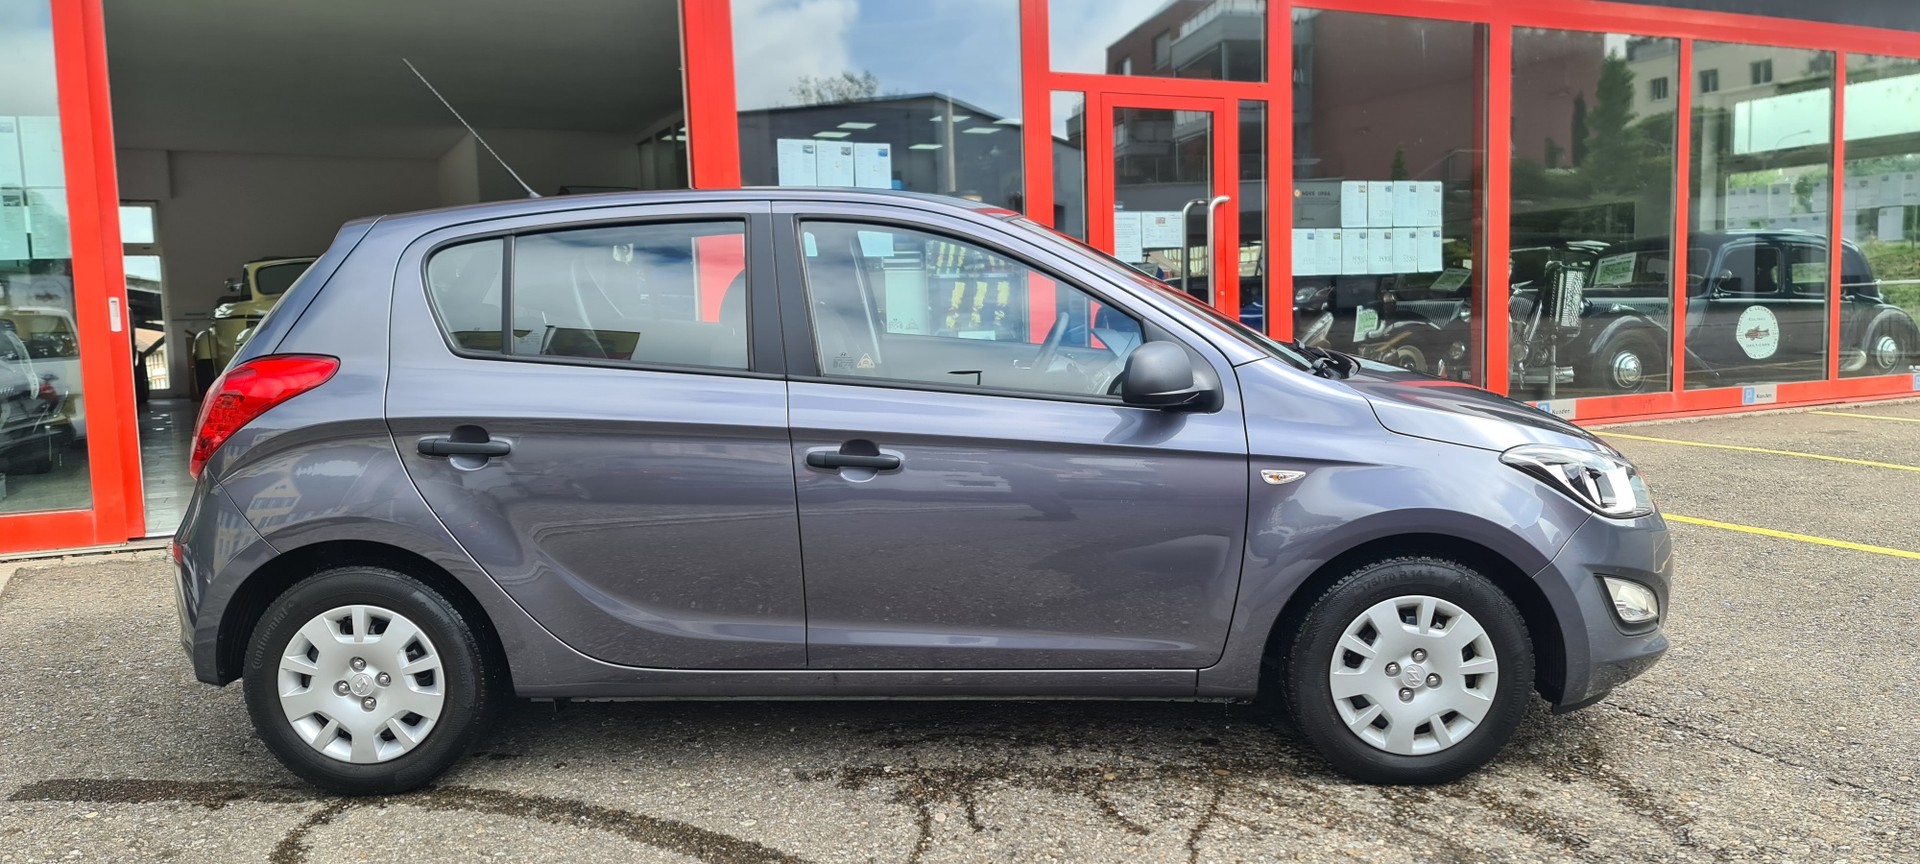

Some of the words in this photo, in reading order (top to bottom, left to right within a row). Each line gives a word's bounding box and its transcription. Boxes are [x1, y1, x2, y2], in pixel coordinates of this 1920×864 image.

[1362, 573, 1397, 591] 175/70
[1399, 570, 1408, 579] R
[1411, 570, 1423, 579] 14
[251, 607, 289, 669] Continental
